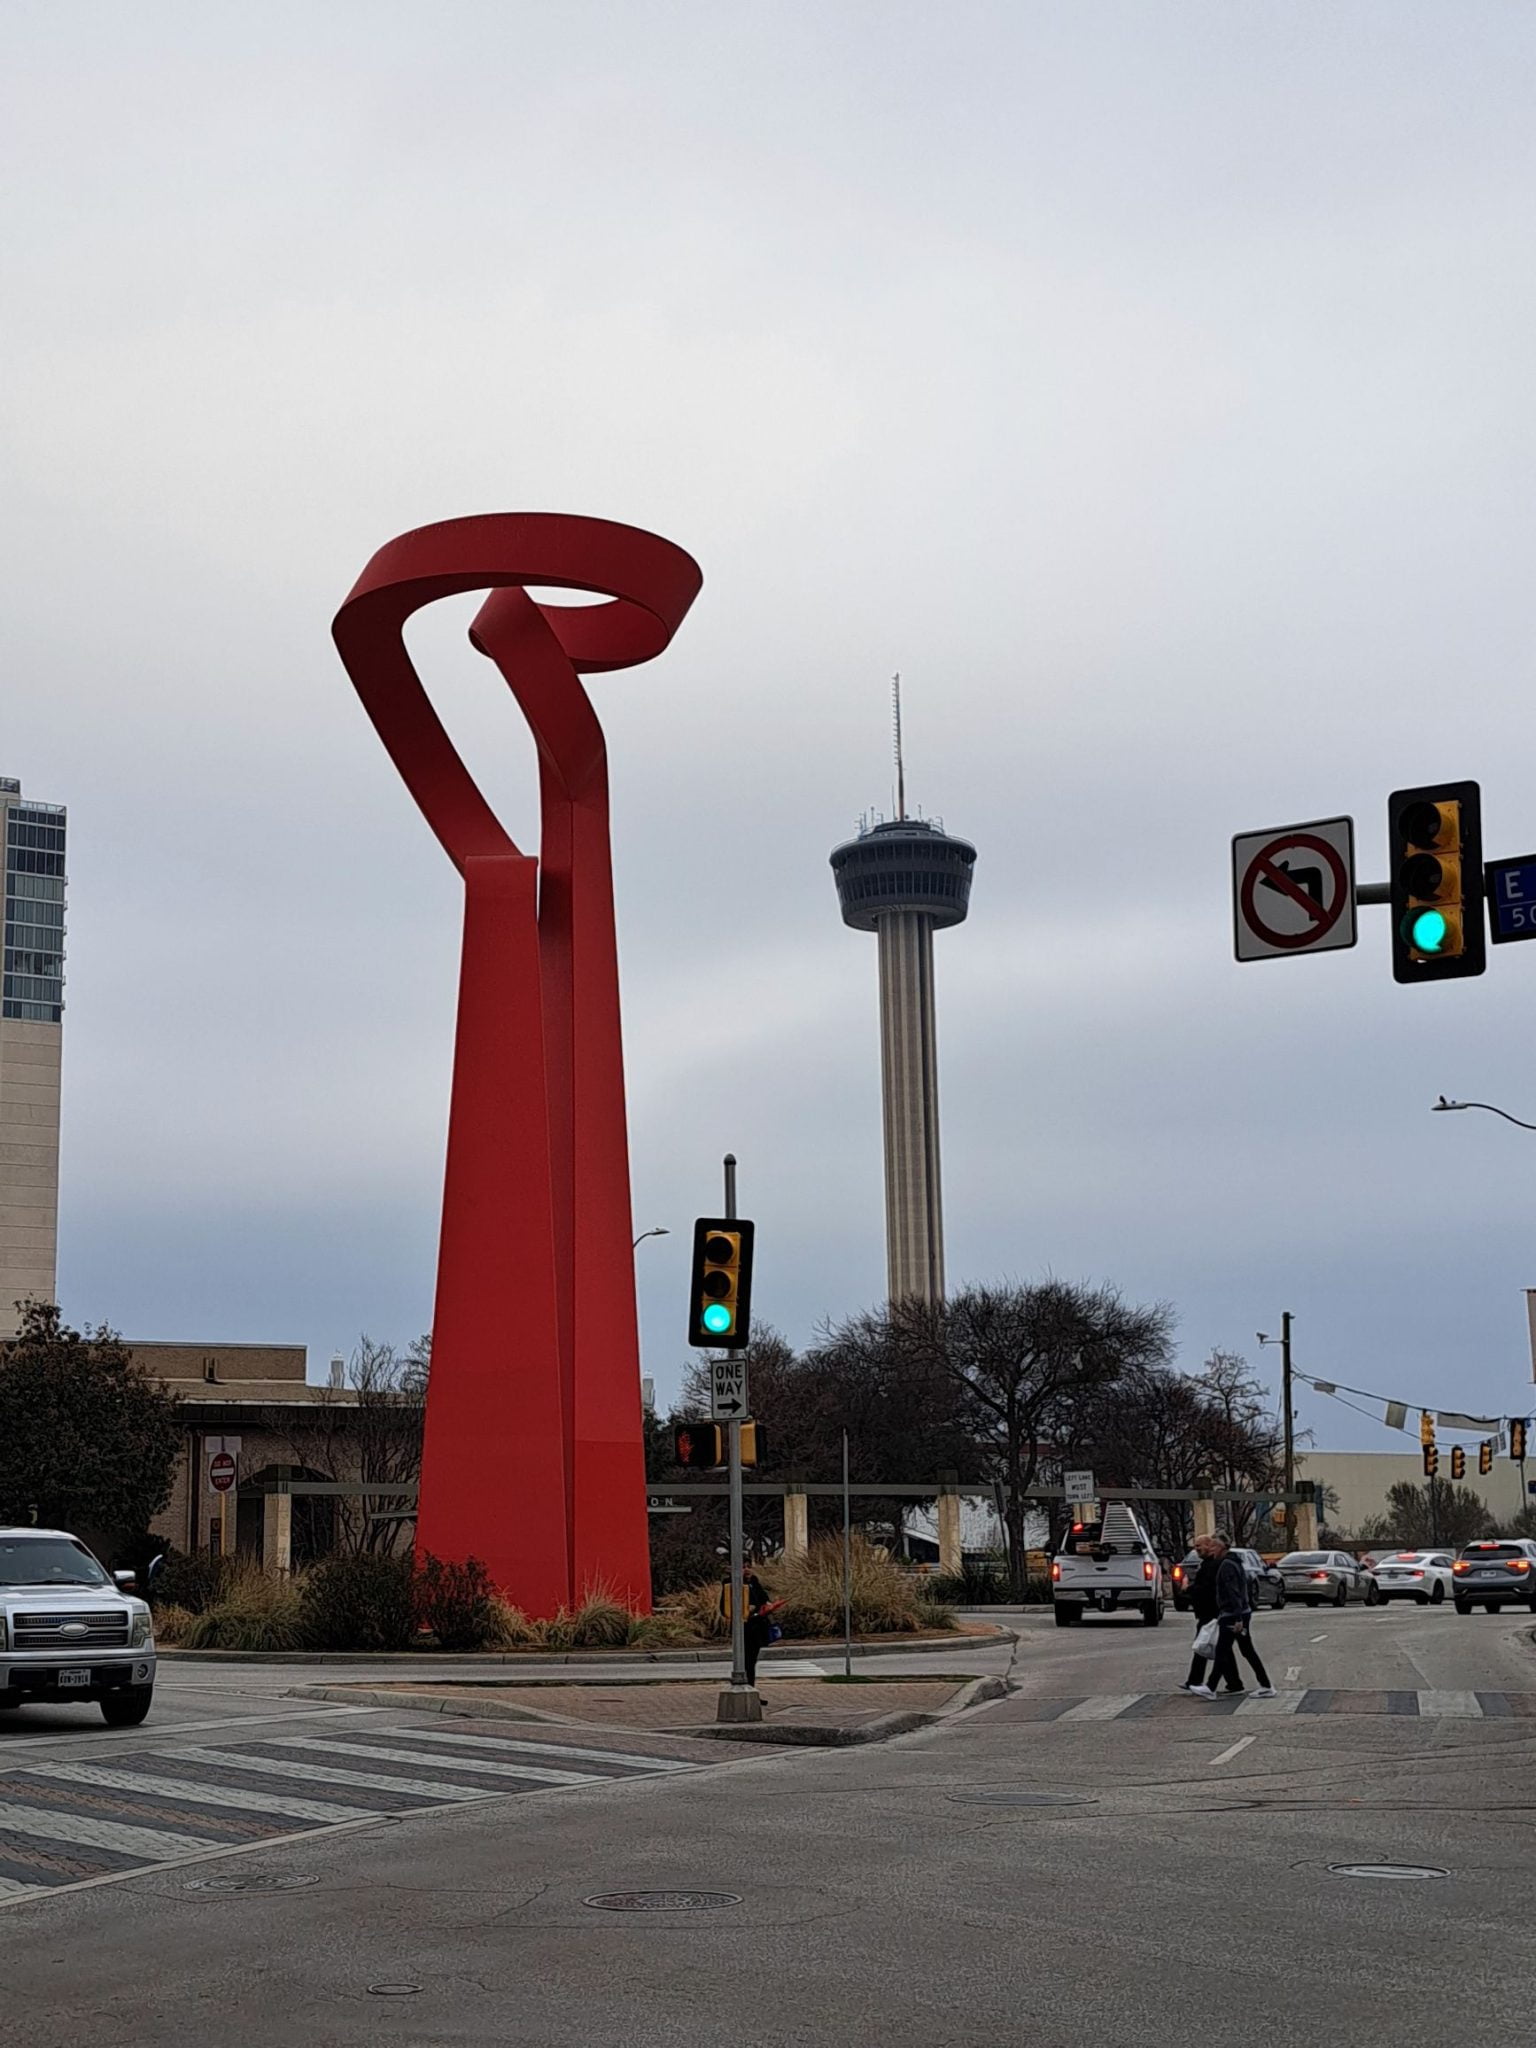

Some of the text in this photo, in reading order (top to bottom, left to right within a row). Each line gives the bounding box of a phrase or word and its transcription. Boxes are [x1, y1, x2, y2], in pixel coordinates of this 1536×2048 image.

[1505, 871, 1523, 898] E
[715, 1365, 743, 1379] ONE
[715, 1380, 743, 1396] WAY
